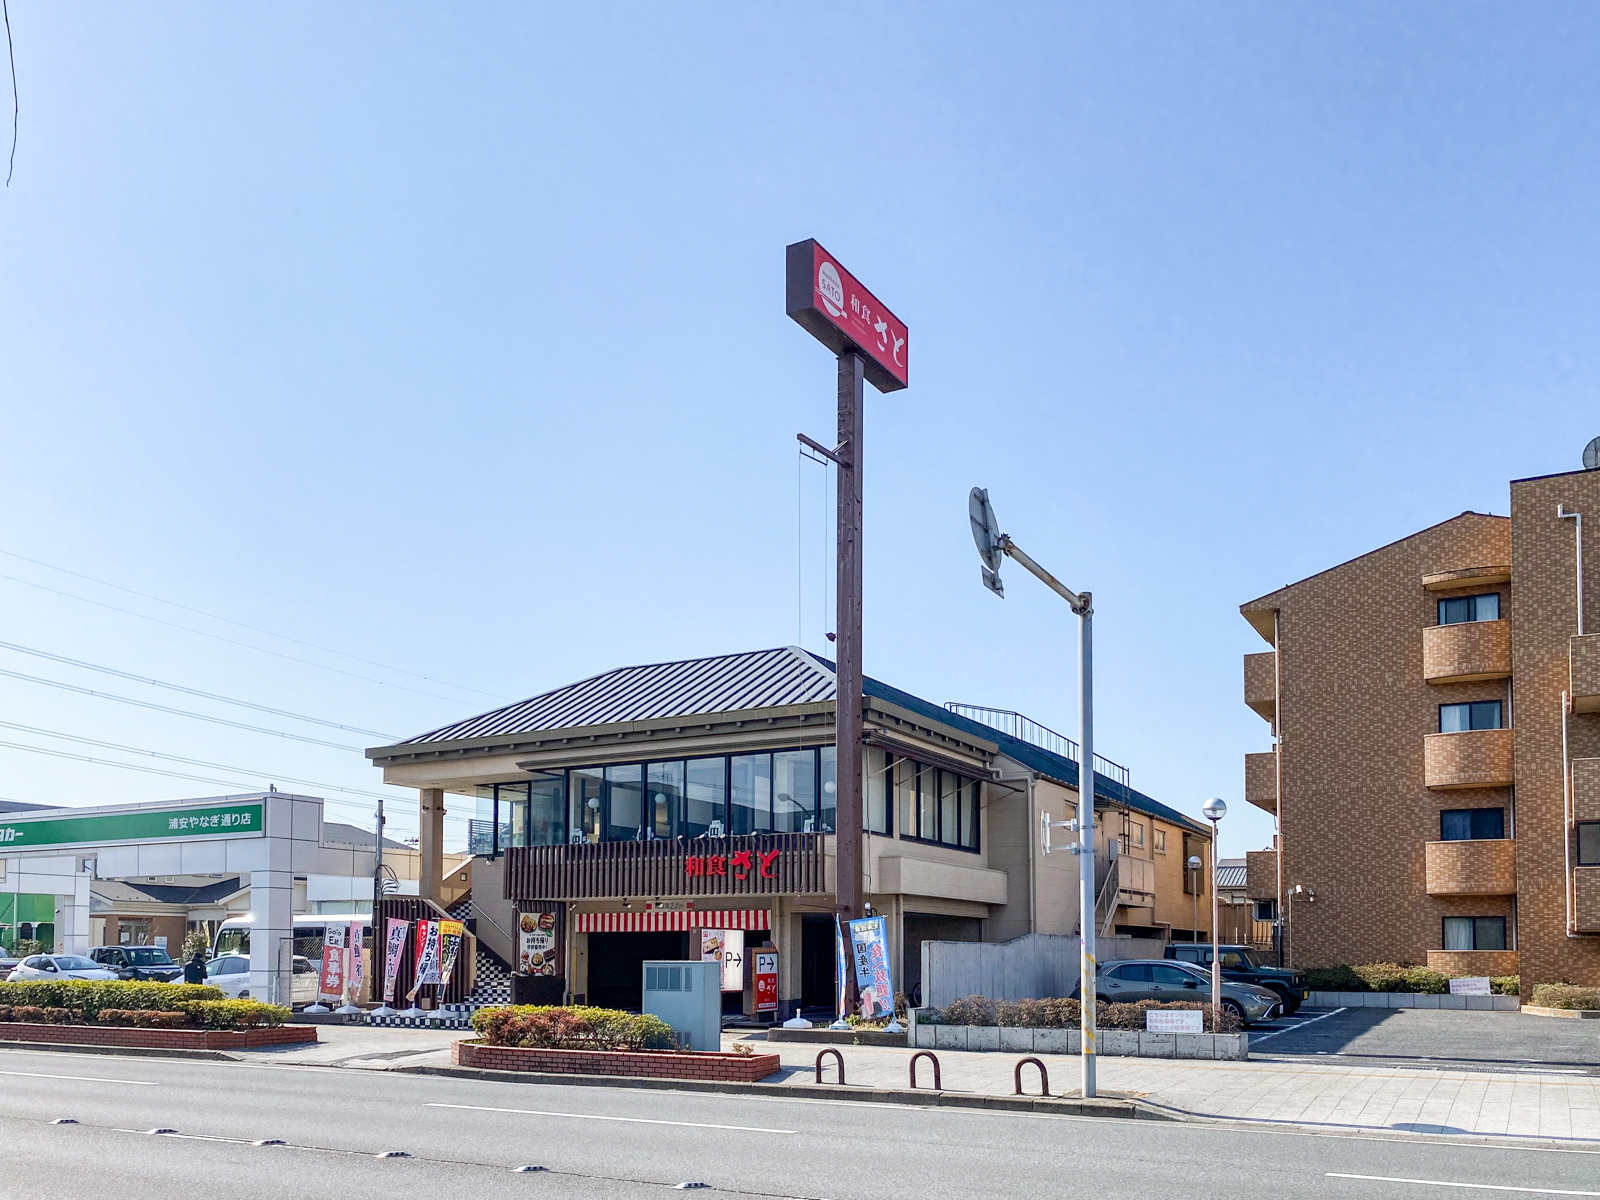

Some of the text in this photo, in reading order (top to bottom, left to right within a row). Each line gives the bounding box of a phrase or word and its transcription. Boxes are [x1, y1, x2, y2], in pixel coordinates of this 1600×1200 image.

[821, 278, 841, 302] SATO
[168, 812, 252, 830] 浦安やなぎ通り店
[684, 849, 780, 880] 和食さと
[326, 948, 340, 988] 食事券
[725, 951, 733, 969] P
[759, 956, 766, 972] P
